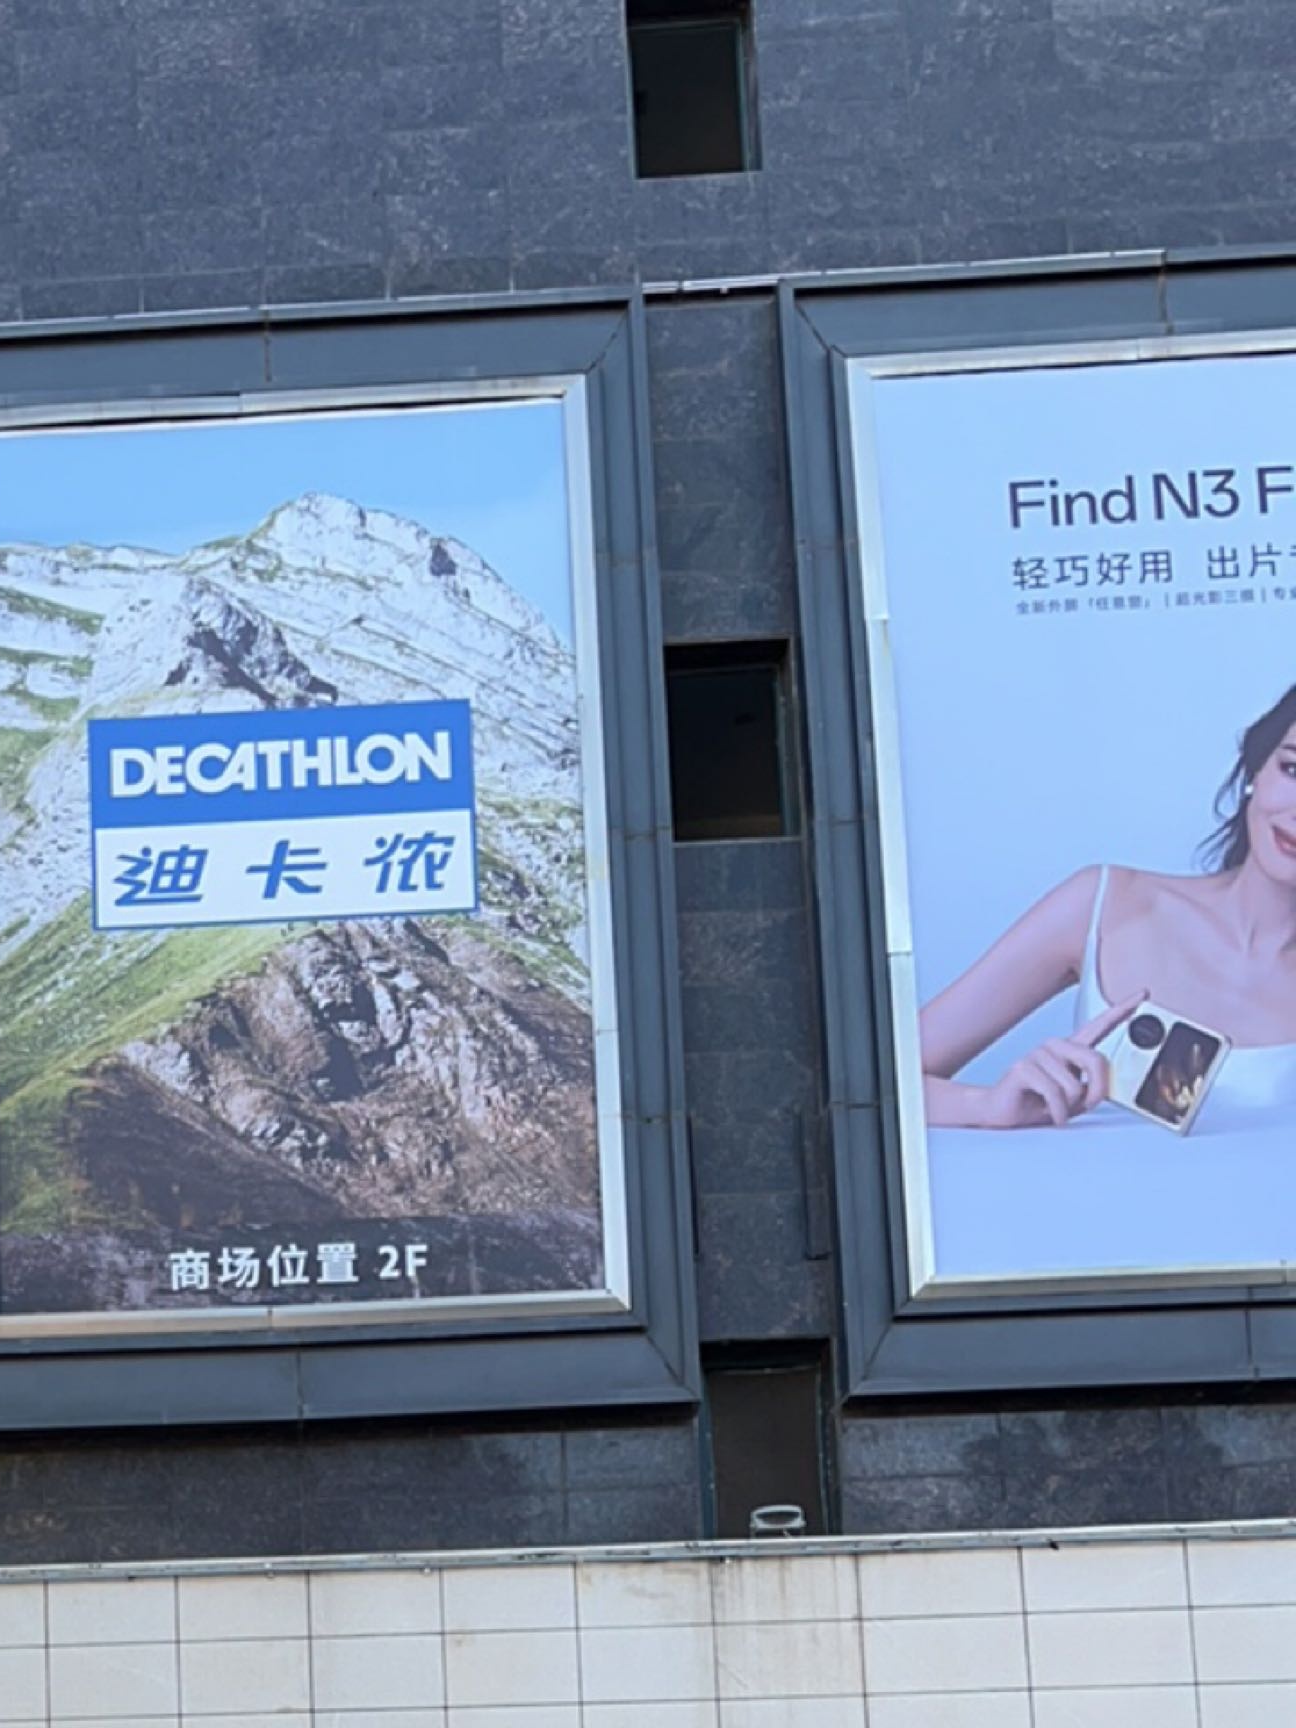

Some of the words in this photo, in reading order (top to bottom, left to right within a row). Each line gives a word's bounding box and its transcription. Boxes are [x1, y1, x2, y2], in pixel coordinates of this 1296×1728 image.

[1008, 474, 1138, 529] Find
[1152, 468, 1241, 521] N3
[1012, 549, 1173, 591] 轻巧好用
[1206, 542, 1296, 579] 出片
[109, 731, 452, 799] DECATHLON
[113, 831, 456, 907] 迪卡侬
[168, 1242, 359, 1291] 商场位置
[378, 1243, 428, 1279] 2F
